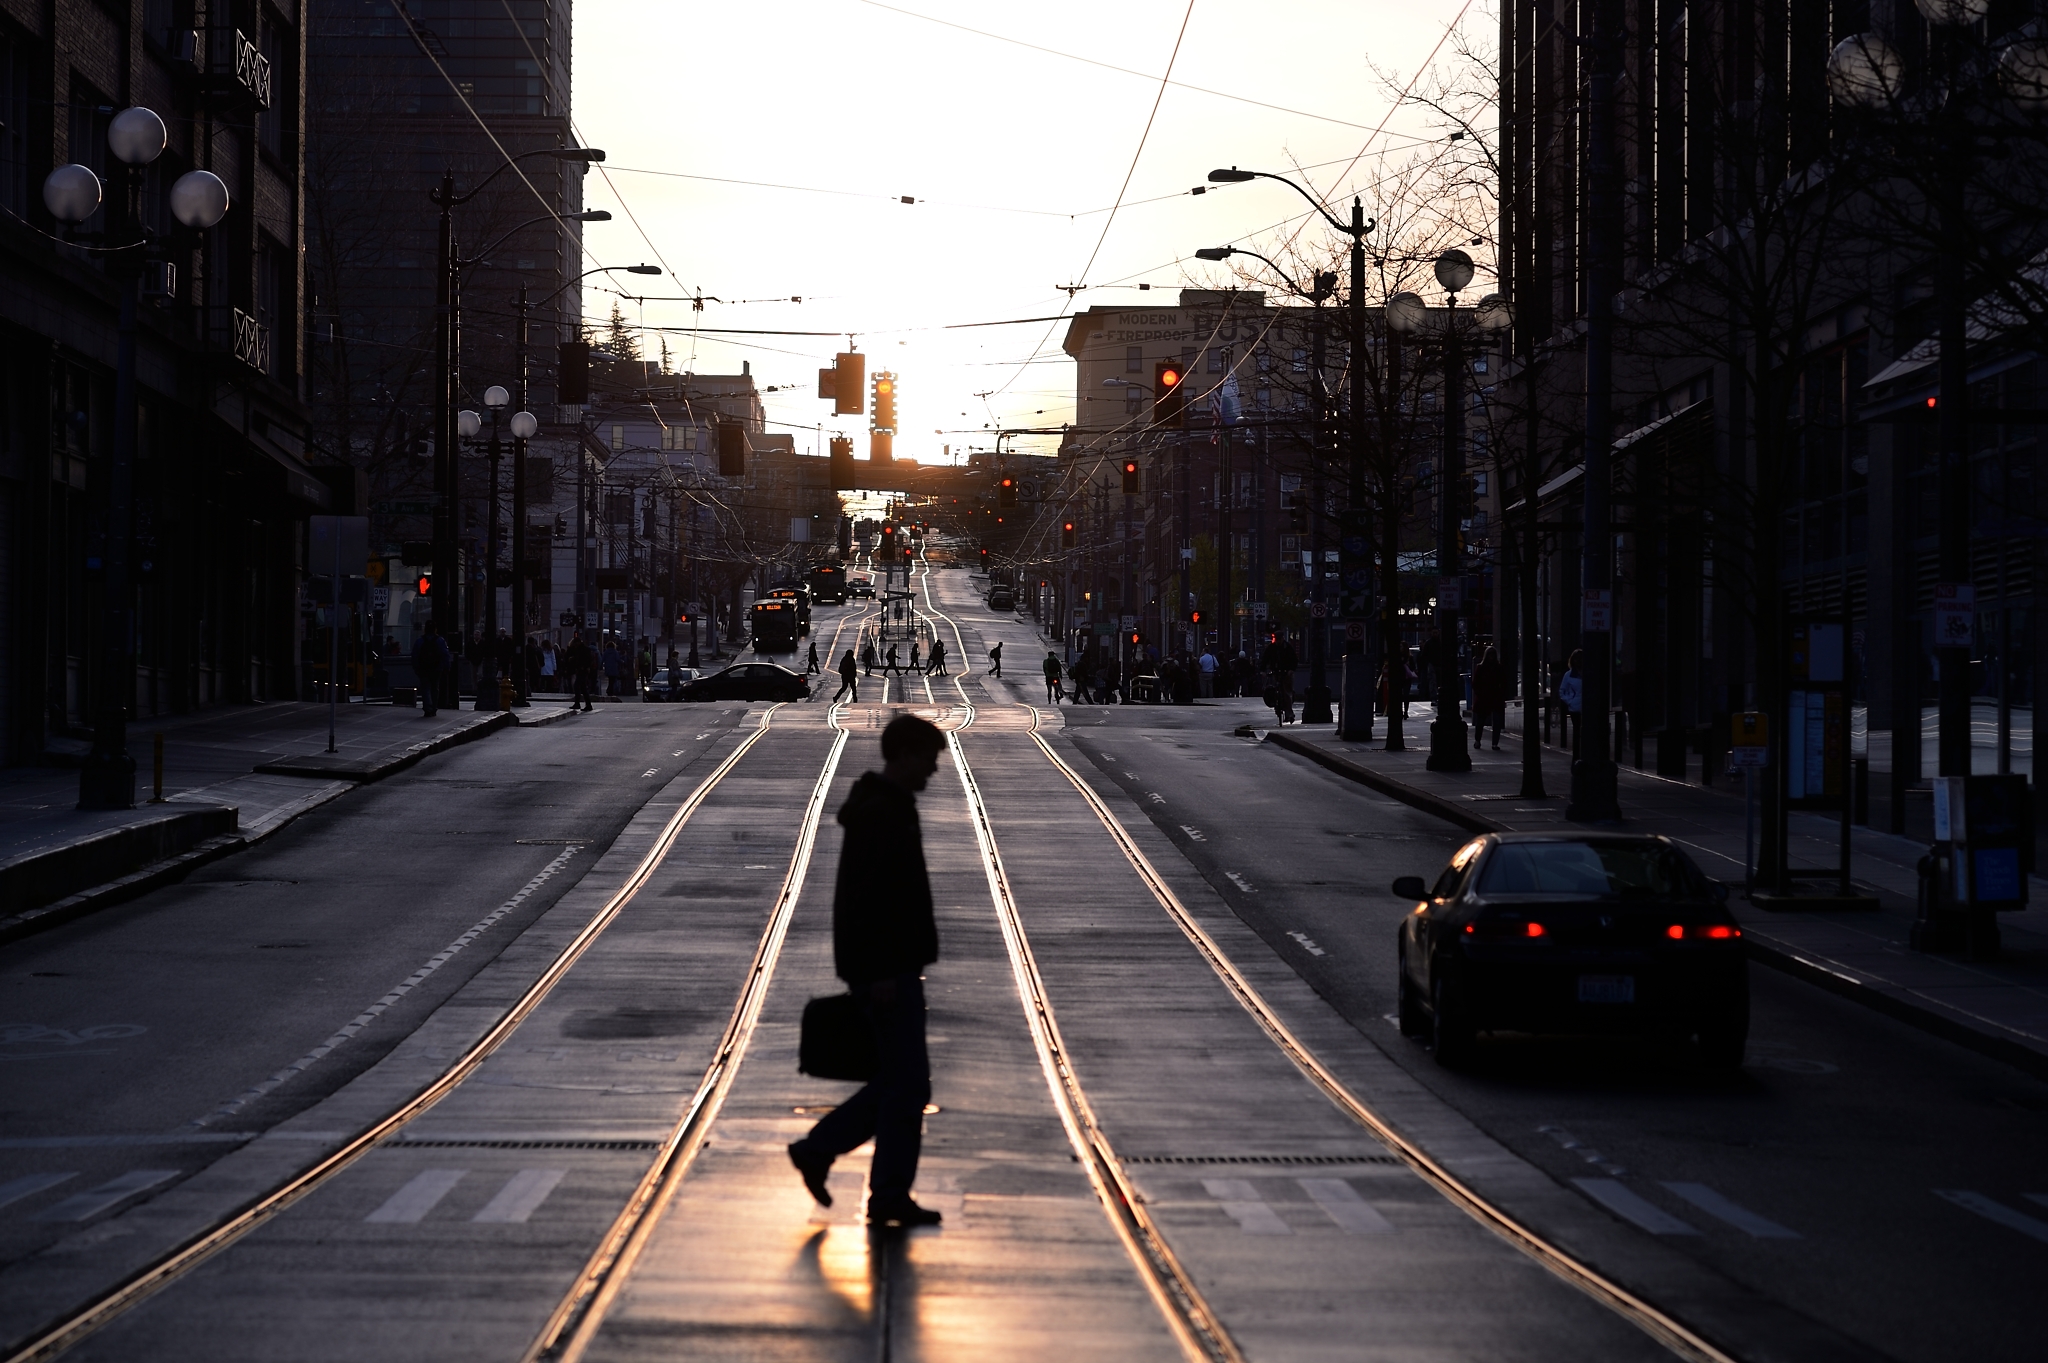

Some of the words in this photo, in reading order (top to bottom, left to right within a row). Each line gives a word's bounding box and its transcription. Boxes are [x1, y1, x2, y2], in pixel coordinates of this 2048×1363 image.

[1119, 314, 1177, 325] MODERN
[1192, 314, 1285, 342] BUSH
[1107, 330, 1193, 342] FIREPROOF
[1353, 536, 1362, 551] 5
[1588, 591, 1598, 599] NO
[1937, 585, 1954, 597] NO
[1587, 601, 1610, 609] PARKING
[1938, 601, 1973, 612] PARKING
[1591, 619, 1605, 627] TIME
